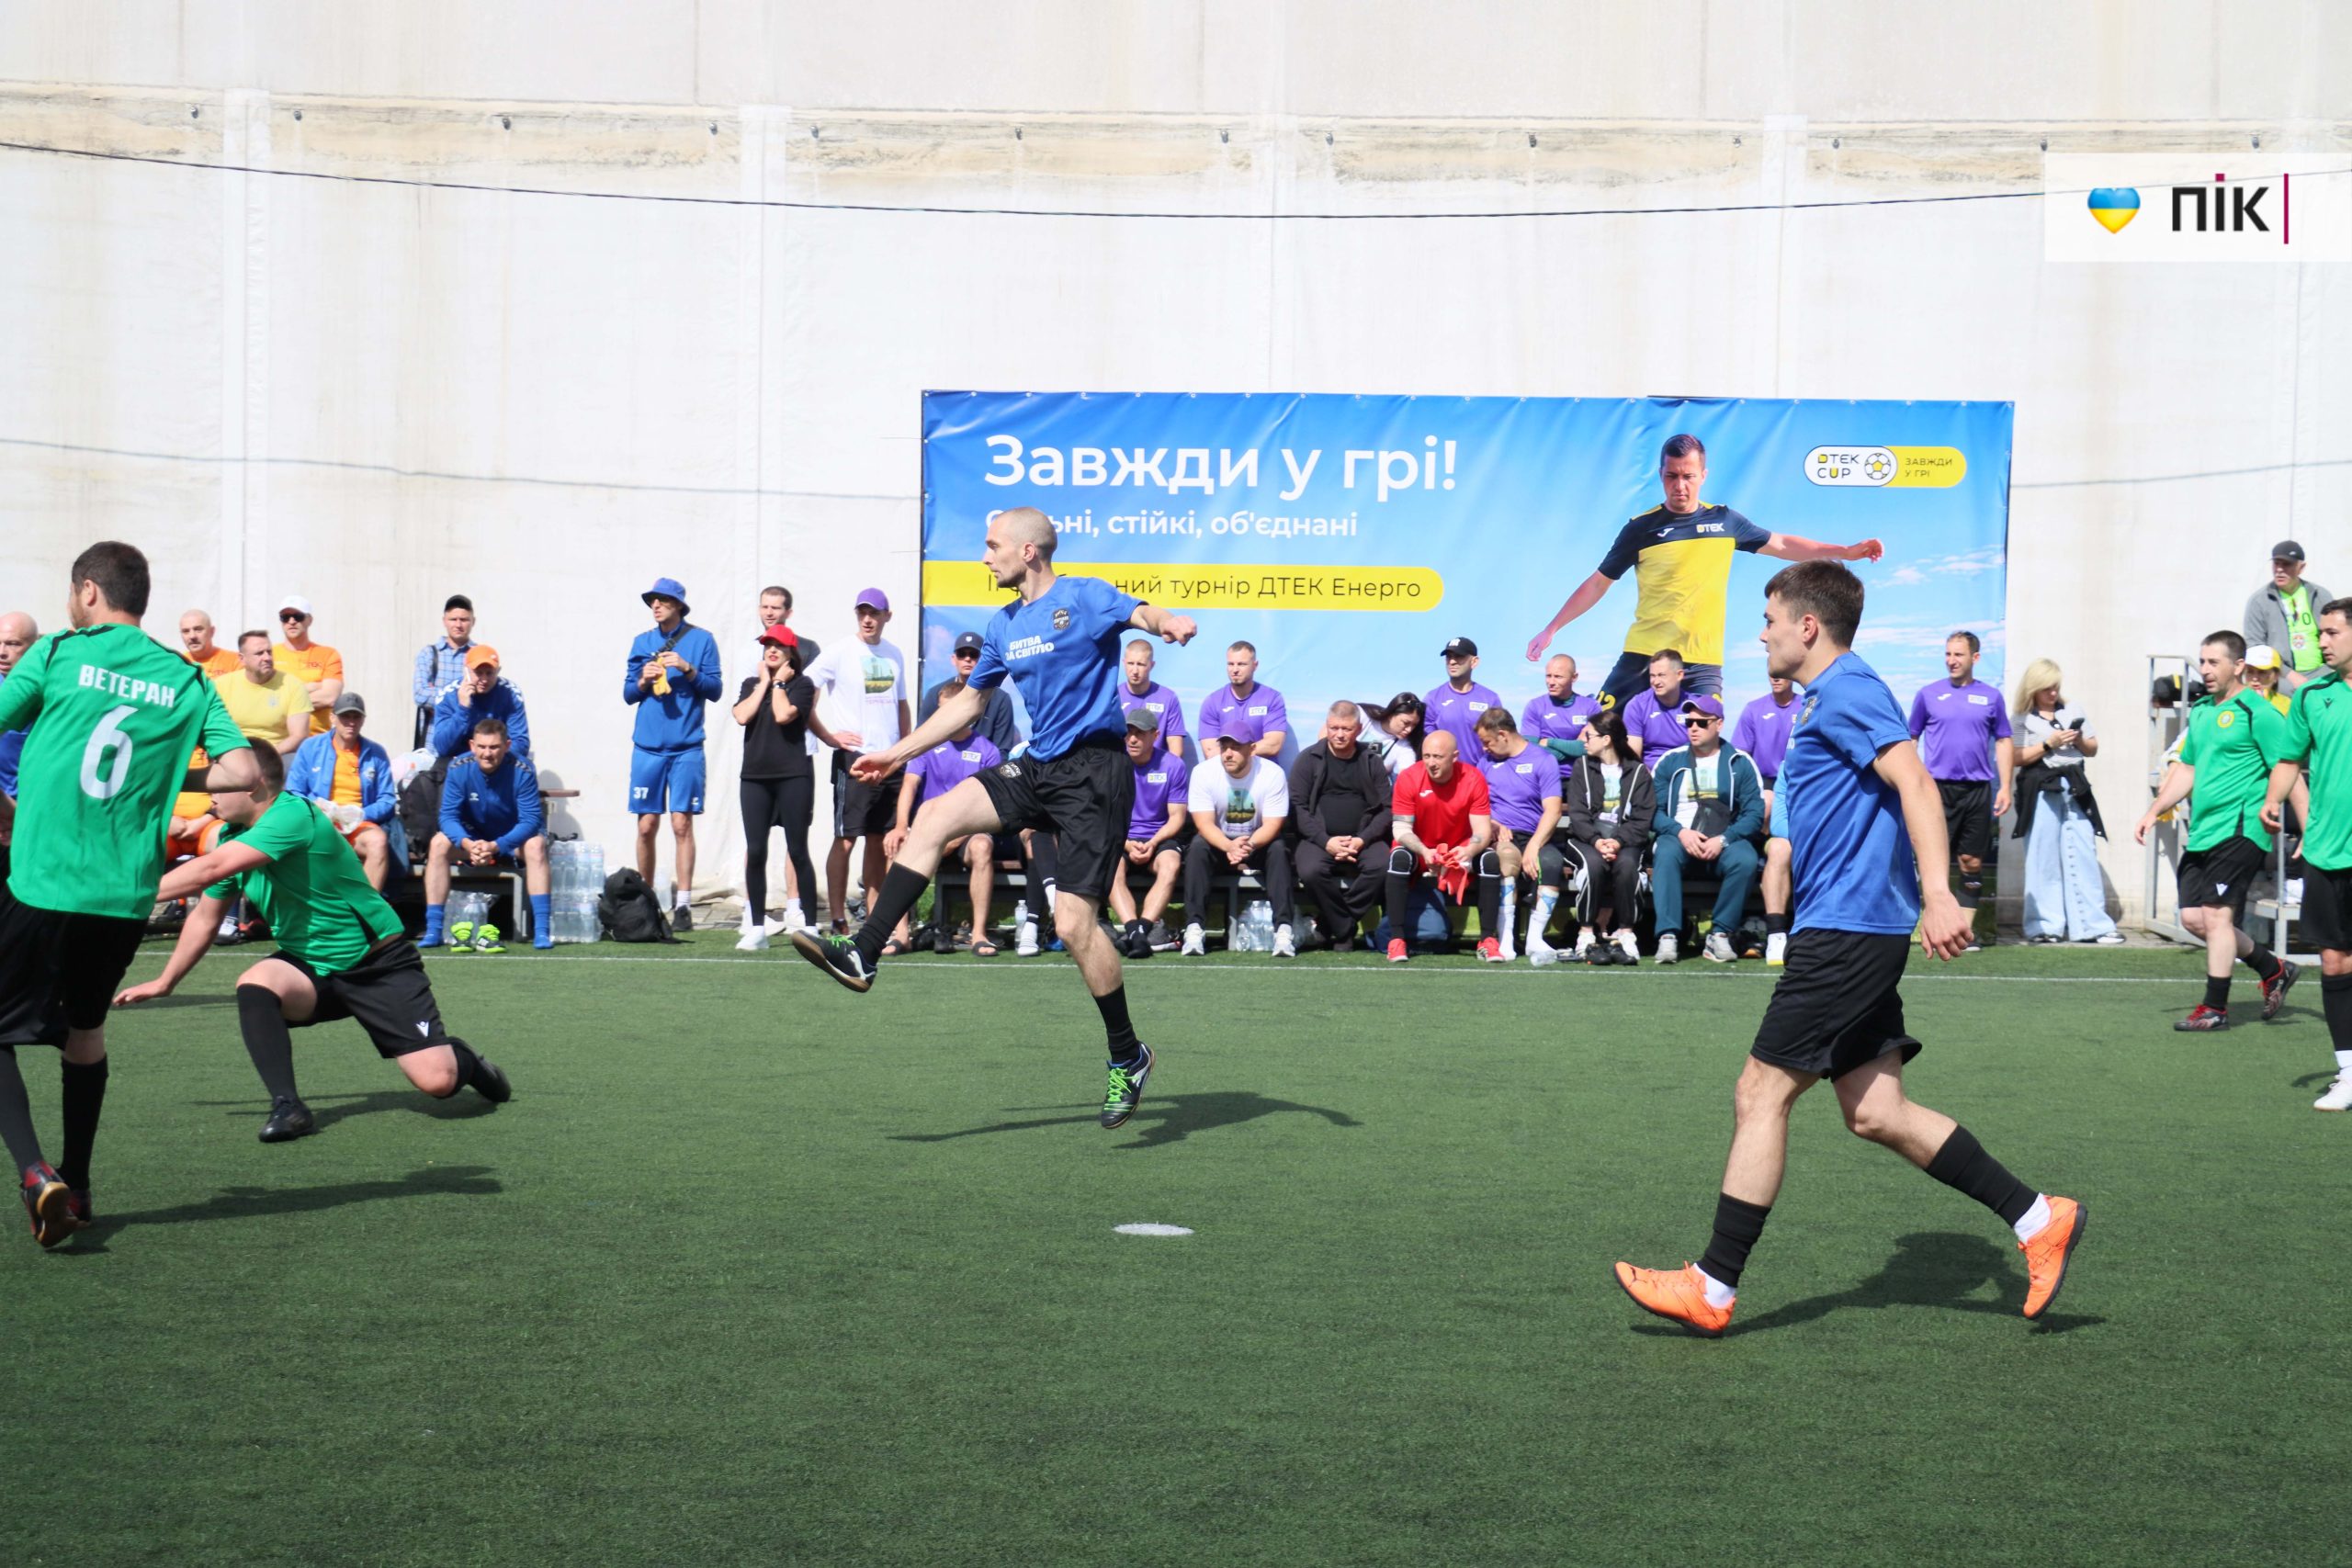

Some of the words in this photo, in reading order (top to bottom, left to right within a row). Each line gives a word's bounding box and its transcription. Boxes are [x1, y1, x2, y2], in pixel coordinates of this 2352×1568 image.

[1817, 454, 1860, 464] DTEK
[1905, 457, 1953, 467] ЗАВЖДИ
[984, 434, 1259, 494] Завжди
[1280, 448, 1322, 501] у
[1343, 435, 1457, 502] грі!
[1817, 468, 1851, 479] CUP
[1905, 469, 1911, 478] У
[1915, 469, 1930, 478] ГРІ
[986, 509, 1100, 537] ьні,
[1107, 509, 1203, 538] стійкі,
[1210, 511, 1358, 539] об'єднані
[1170, 575, 1250, 598] турнір
[1258, 577, 1324, 598] ДТЕК
[1332, 578, 1421, 601] Енерго
[1009, 635, 1043, 650] БИТВА
[1015, 641, 1055, 660] СВІТЛО
[78, 664, 175, 708] ВЕТЕРАН
[79, 704, 139, 800] 6
[632, 786, 650, 800] 37
